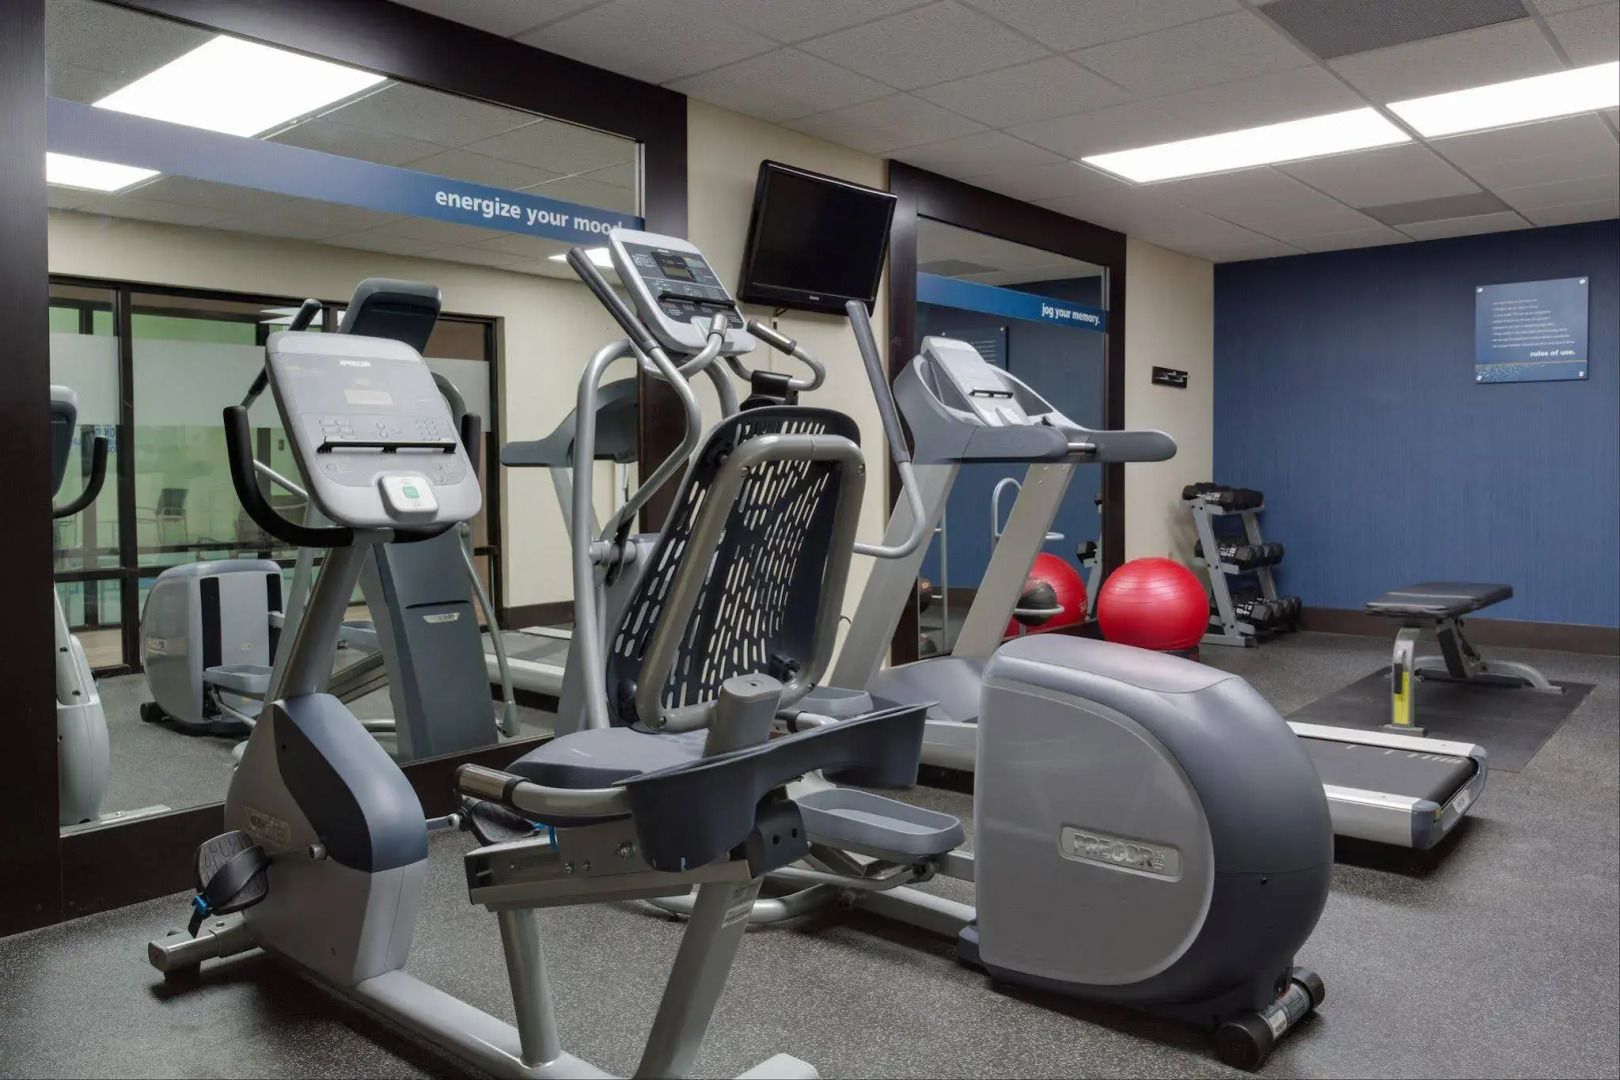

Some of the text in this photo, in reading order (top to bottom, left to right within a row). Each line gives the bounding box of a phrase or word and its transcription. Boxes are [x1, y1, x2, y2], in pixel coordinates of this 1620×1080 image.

[435, 190, 521, 219] energize
[526, 206, 569, 226] your
[1041, 302, 1101, 326] jog your memory.
[1550, 349, 1559, 357] of
[1073, 832, 1153, 868] PRECOR
